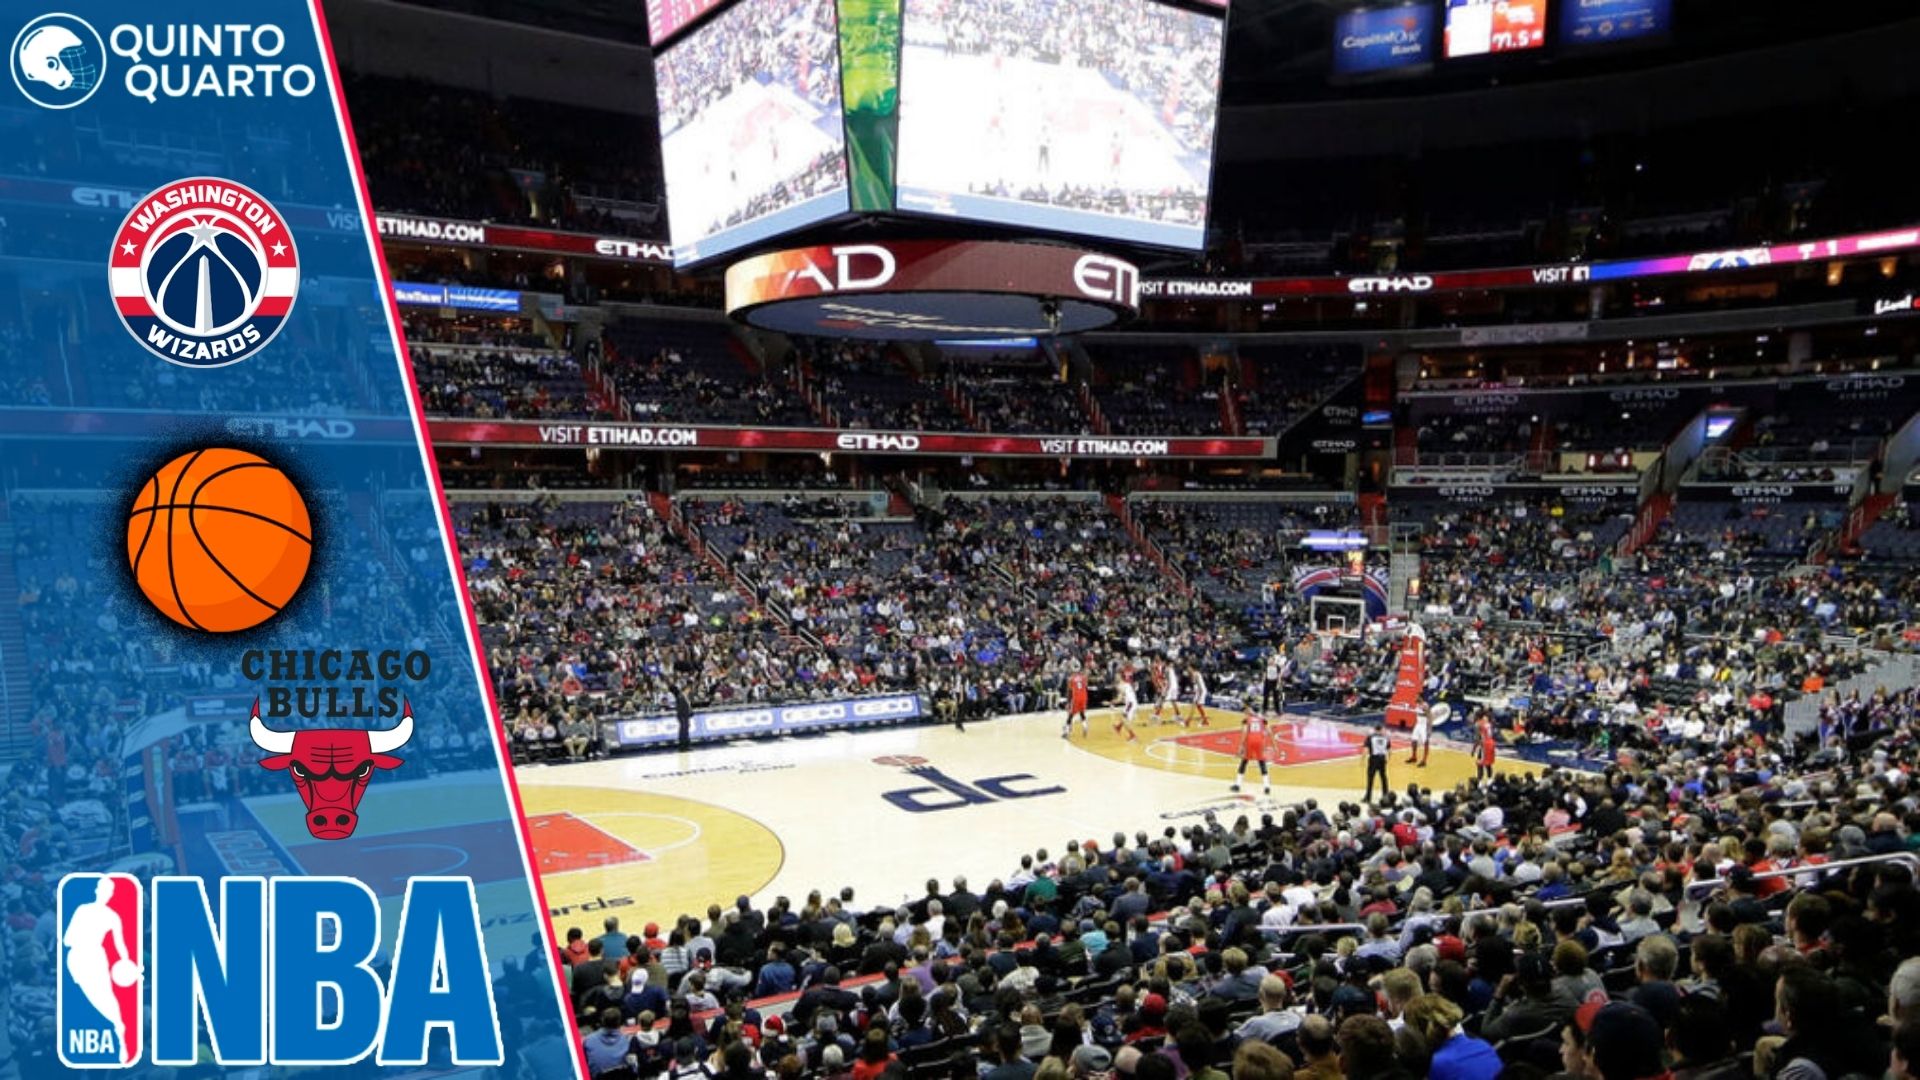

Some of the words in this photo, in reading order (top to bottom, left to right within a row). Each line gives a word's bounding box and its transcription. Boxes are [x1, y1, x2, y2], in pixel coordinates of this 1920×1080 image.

[326, 212, 361, 231] VISI
[376, 216, 485, 243] ETIHAD.COM
[1532, 267, 1570, 283] VISIT
[1137, 281, 1165, 294] ISIT
[1167, 281, 1252, 296] ETIHAD.COM
[1348, 276, 1433, 292] ETIHAD
[224, 417, 356, 438] ETIHAD
[538, 426, 583, 443] VISIT
[587, 427, 697, 446] ETIHAD.COM
[837, 434, 920, 450] ETIHAD
[1040, 439, 1073, 453] VISIT
[1077, 440, 1168, 455] ETIHAD.COM
[706, 710, 774, 730] GEICO
[781, 703, 846, 723] GEICO
[853, 697, 914, 716] GEICO
